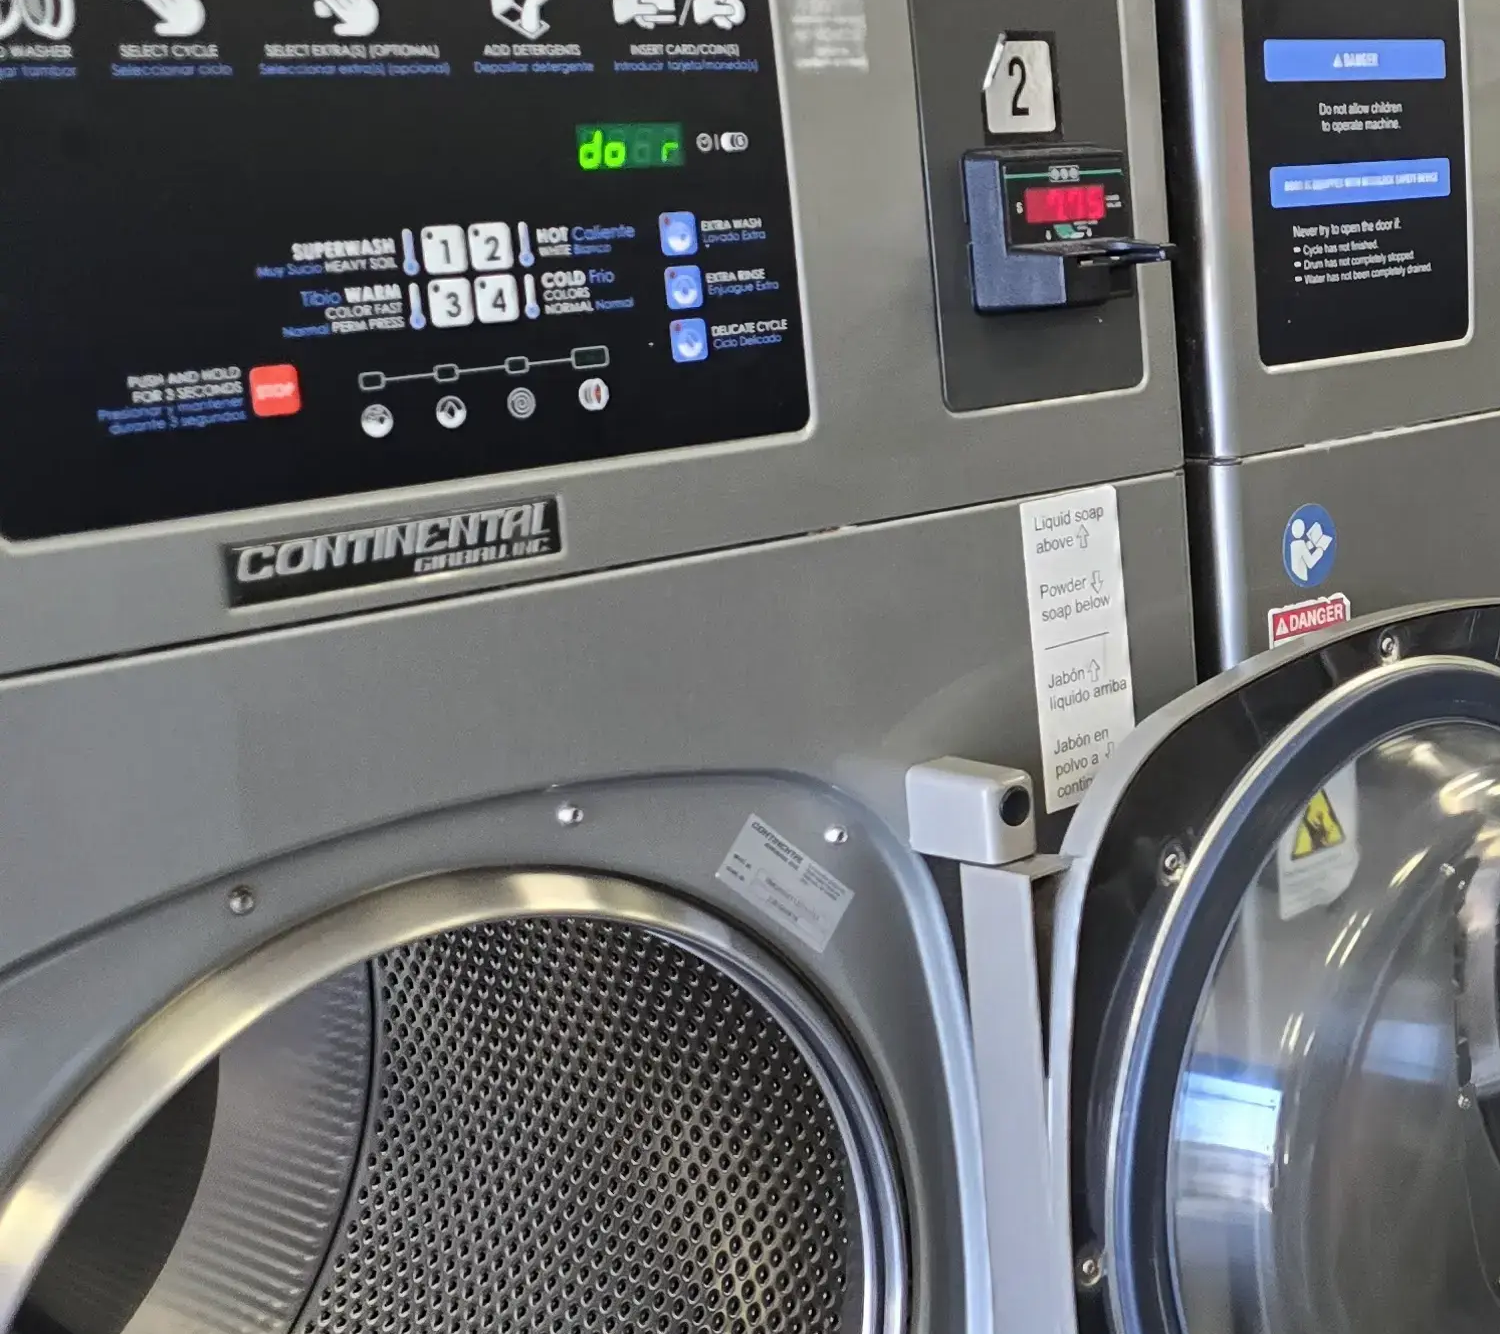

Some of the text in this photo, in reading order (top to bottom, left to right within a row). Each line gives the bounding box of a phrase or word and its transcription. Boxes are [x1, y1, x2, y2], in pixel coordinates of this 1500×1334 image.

[119, 44, 219, 58] SELECT CYCLE
[264, 44, 309, 58] SELECT
[484, 44, 511, 56] ADD
[1008, 56, 1030, 117] 2
[1319, 102, 1402, 115] Do not allow children
[1322, 121, 1330, 132] to
[1332, 120, 1363, 133] operate
[536, 223, 635, 244] HOT Caliente
[701, 217, 762, 231] EXTRA WASH
[1293, 219, 1393, 238] Never try to open the door
[703, 229, 766, 243] Lavado Extra
[292, 237, 396, 262] SUPERWASH
[440, 239, 451, 265] 1
[484, 236, 501, 261] 2
[1303, 245, 1323, 257] Cycle
[1324, 243, 1337, 253] has
[1338, 243, 1350, 252] not
[325, 259, 367, 273] HEAVY
[370, 256, 397, 270] SOIL
[1304, 253, 1386, 270] Drum has not completely
[541, 270, 586, 288] COLD
[706, 269, 766, 284] EXTRA RINSE
[1304, 266, 1406, 285] Water has not been completely
[301, 283, 402, 307] Tibio WARM
[543, 287, 590, 301] COLORS
[708, 279, 779, 295] Enjuague Extra
[446, 292, 462, 318] 3
[491, 288, 508, 313] 4
[544, 297, 634, 314] NORMAL Normal
[325, 302, 403, 320] COLOR FAST
[332, 319, 366, 334] PERM
[368, 316, 404, 330] PRESS
[711, 319, 788, 337] DELICATE CYCLE
[713, 333, 781, 349] Ciclo Delicado
[1034, 505, 1105, 533] Liquid soap
[234, 501, 551, 582] CONTINENTAL
[1036, 534, 1074, 555] above
[1040, 577, 1087, 599] Powder
[1042, 594, 1111, 622] soap below
[1289, 601, 1344, 632] DANGER
[1048, 669, 1086, 690] Jabón
[1093, 678, 1128, 698] arriba
[1054, 728, 1109, 755] Jabón en
[1055, 754, 1099, 780] polvo a
